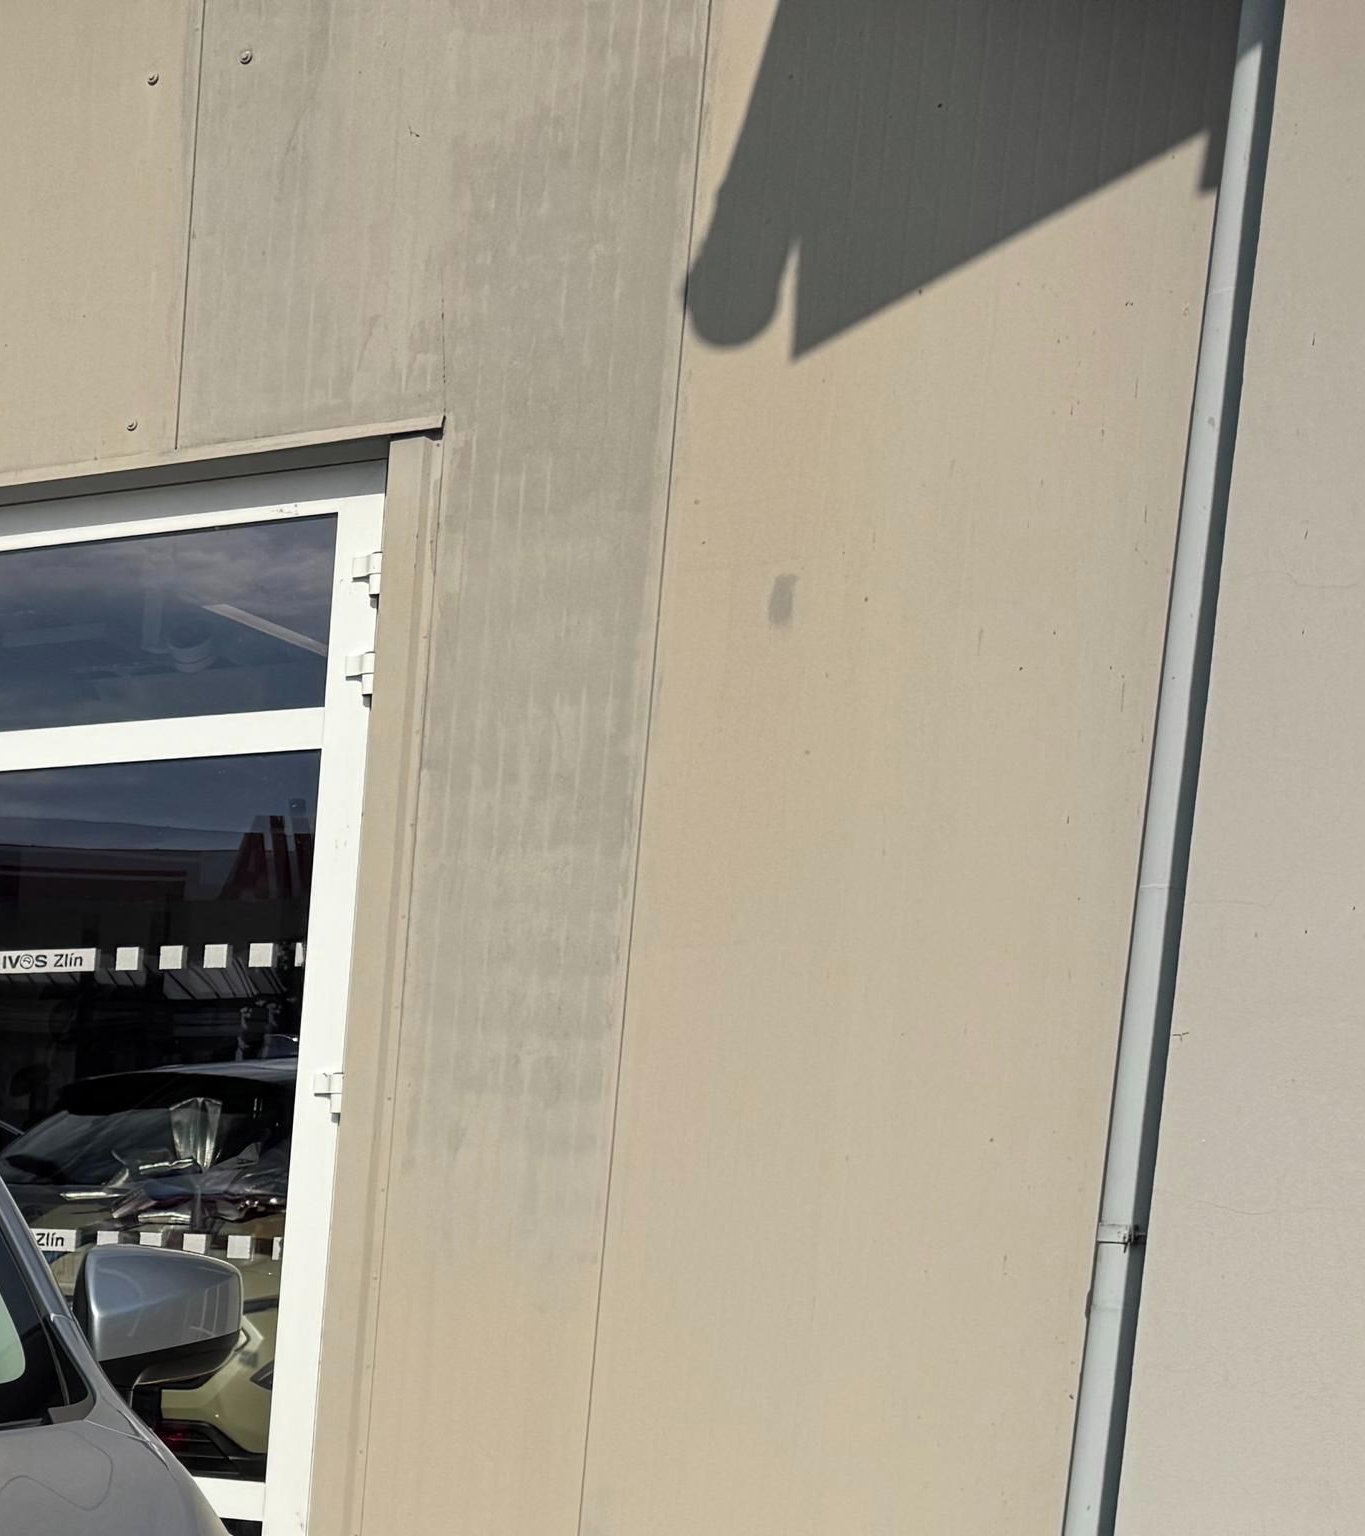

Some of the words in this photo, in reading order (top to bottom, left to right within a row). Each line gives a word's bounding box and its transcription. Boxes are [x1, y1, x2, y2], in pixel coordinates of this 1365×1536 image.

[2, 953, 48, 970] IVOS
[53, 952, 84, 968] Zlín
[35, 1231, 65, 1247] Zlín
